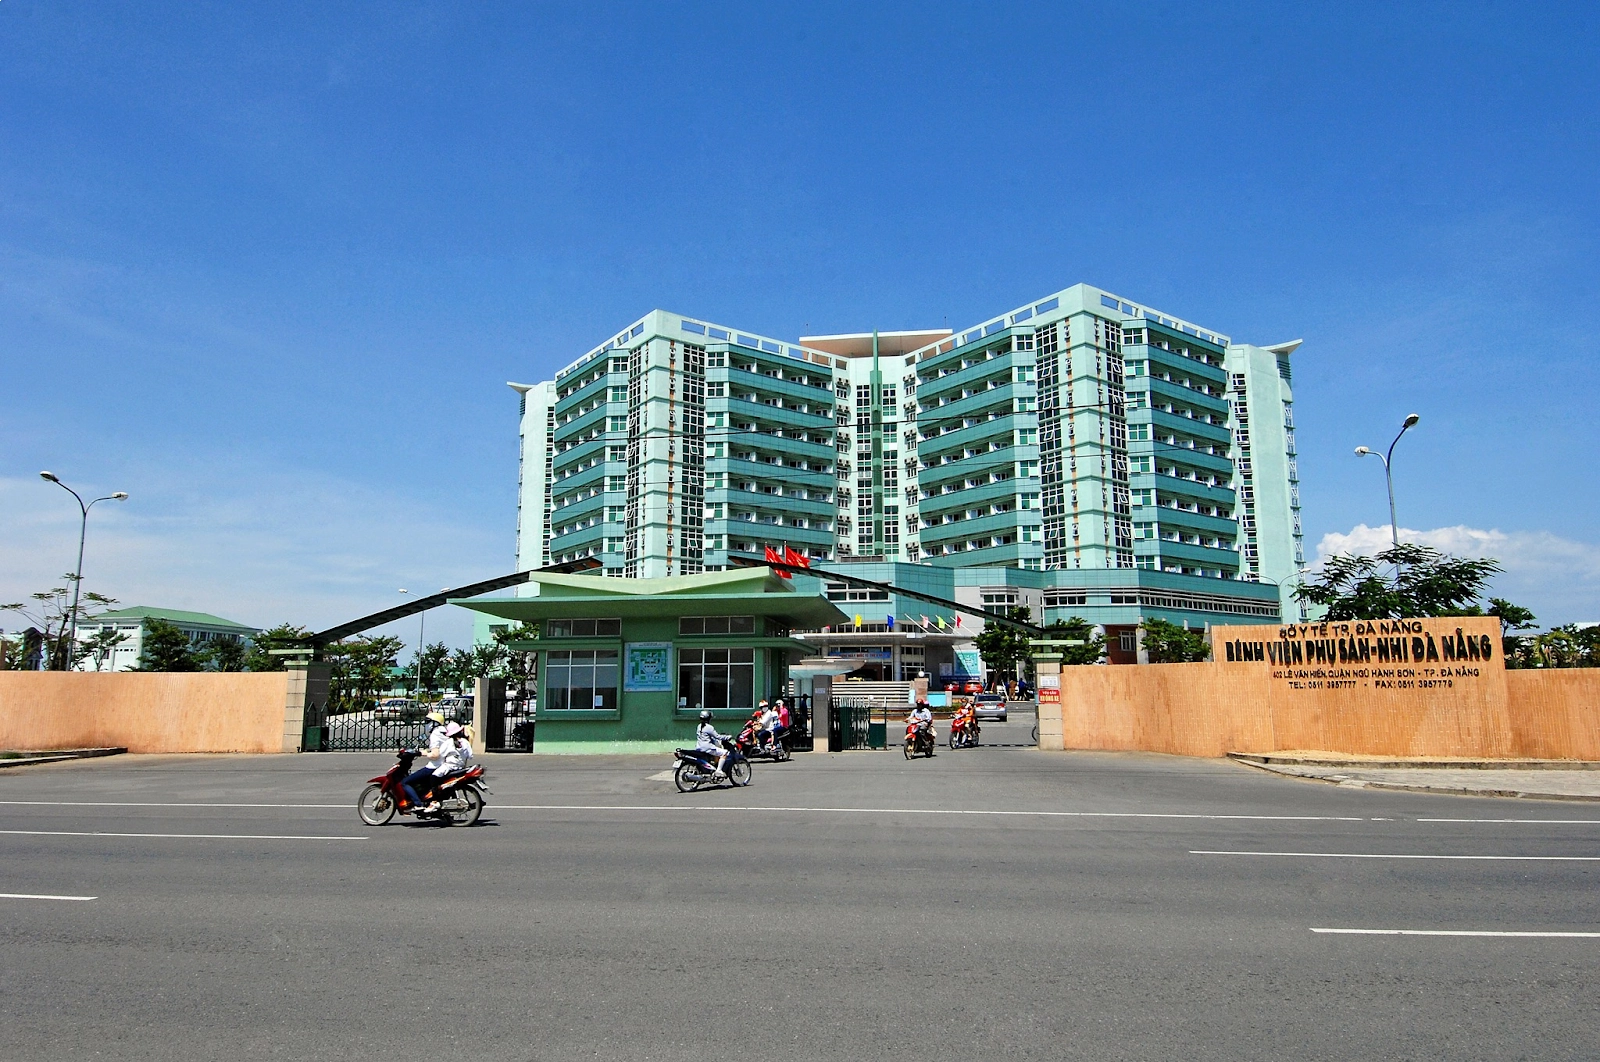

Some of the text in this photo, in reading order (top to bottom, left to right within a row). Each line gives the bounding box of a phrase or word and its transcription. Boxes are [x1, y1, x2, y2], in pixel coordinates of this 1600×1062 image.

[1299, 626, 1308, 638] Y
[1310, 622, 1328, 637] TẾ
[1356, 620, 1376, 635] ĐÀ
[1267, 638, 1303, 668] VIỆN
[1412, 632, 1439, 662] ĐÀ
[1442, 628, 1492, 662] NẴNG
[1284, 670, 1292, 678] LÊ
[1328, 668, 1350, 680] QUẬN
[1372, 668, 1394, 678] HÀNH
[1441, 667, 1453, 677] ĐÀ
[1288, 681, 1306, 689] TEL:
[1375, 680, 1396, 688] FAX:
